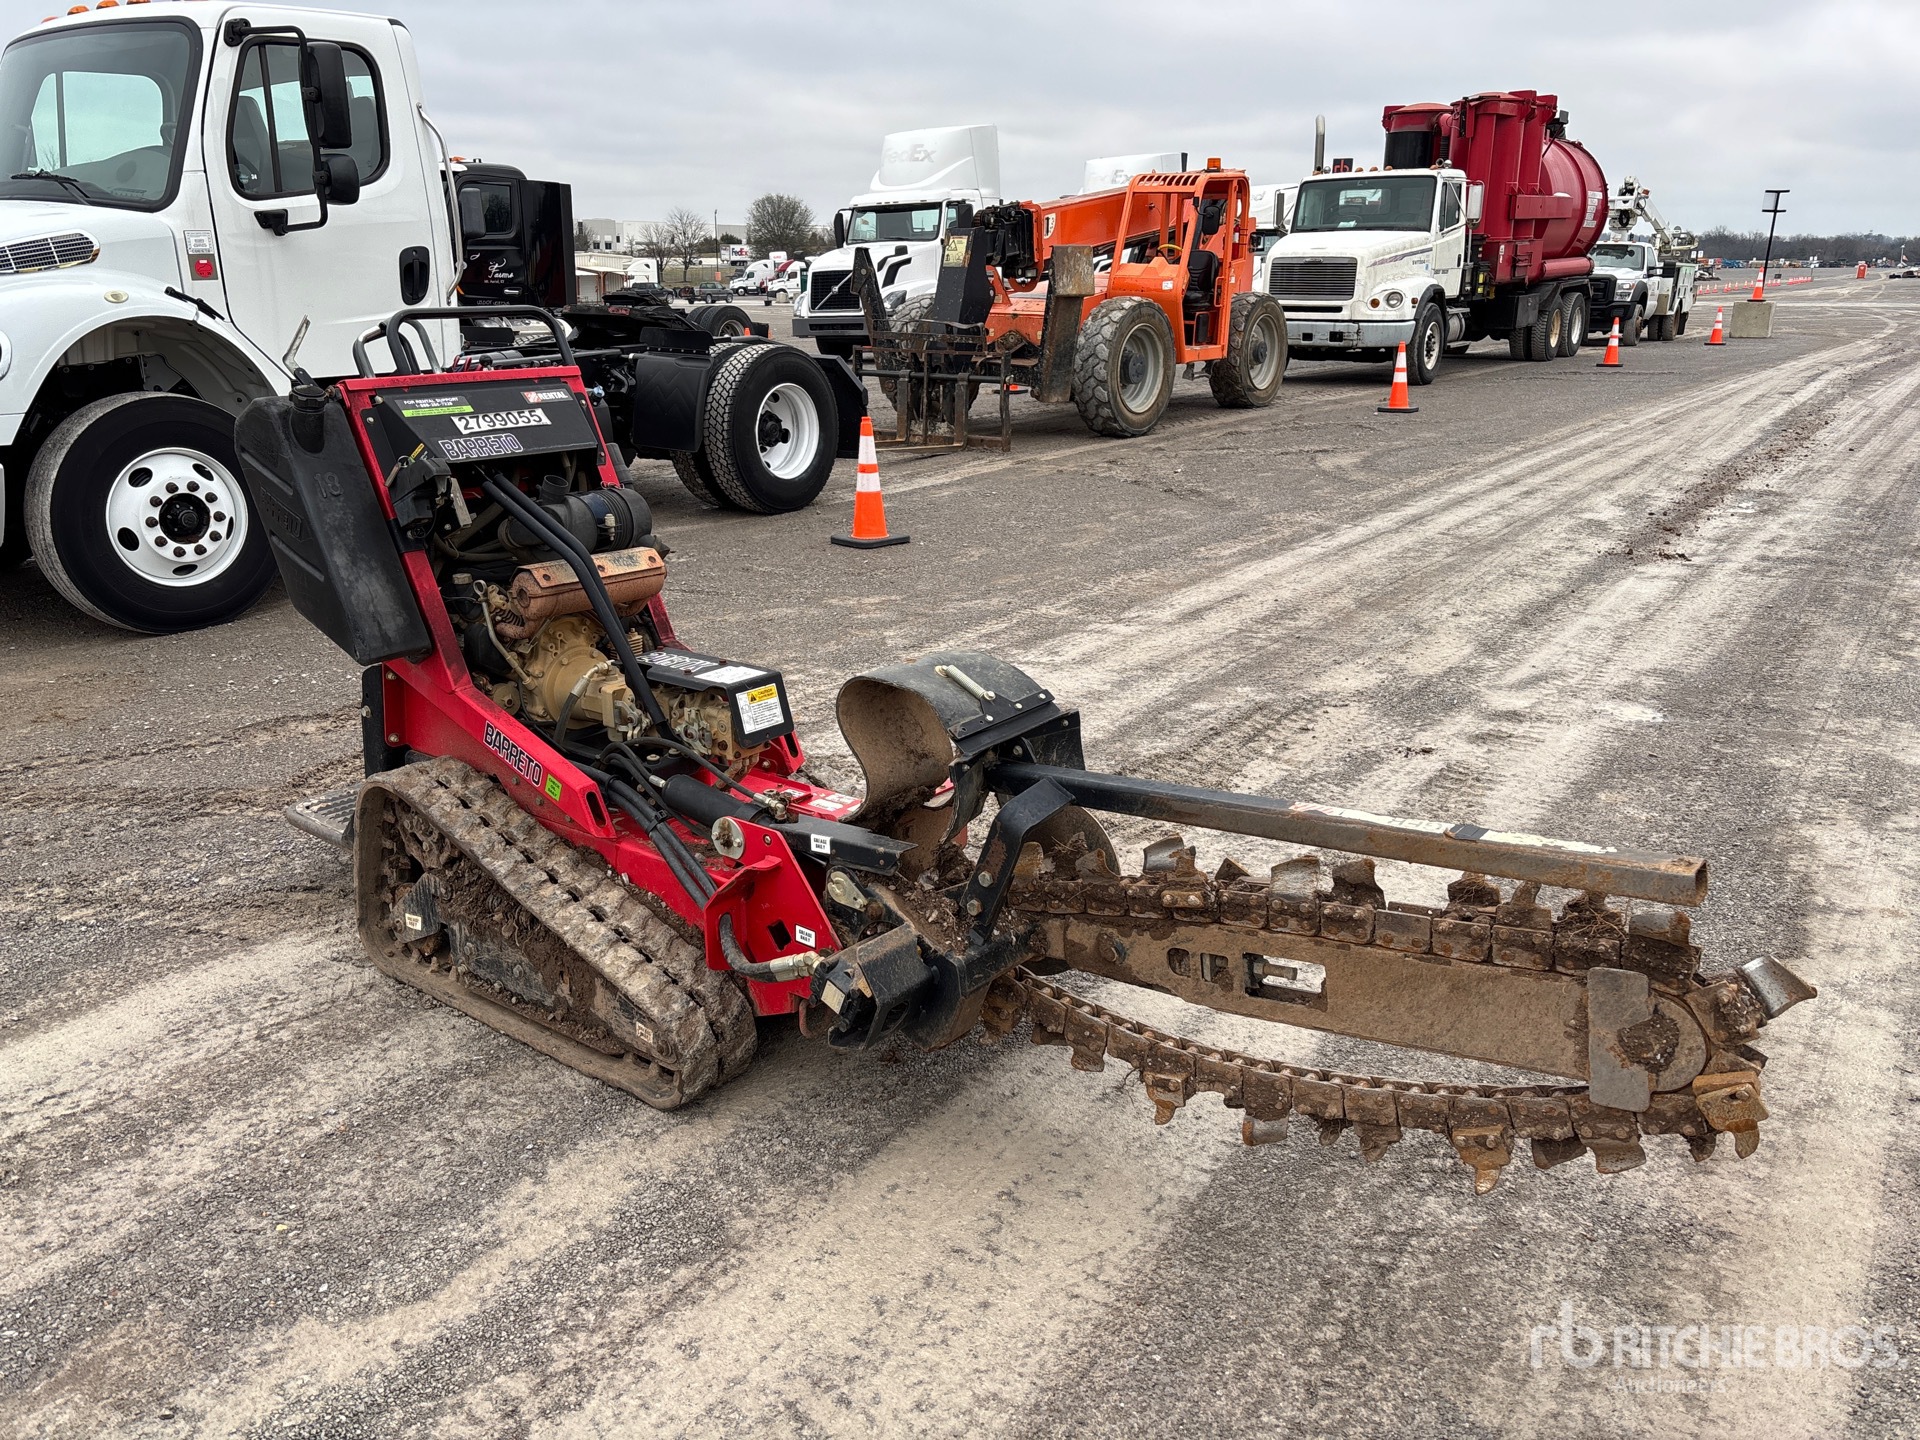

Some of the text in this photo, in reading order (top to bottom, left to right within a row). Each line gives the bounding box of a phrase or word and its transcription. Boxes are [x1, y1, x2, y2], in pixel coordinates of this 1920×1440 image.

[537, 391, 569, 401] RENTAL
[457, 409, 543, 432] 2799055
[438, 432, 524, 461] BARRETO
[482, 720, 543, 787] BARRETO
